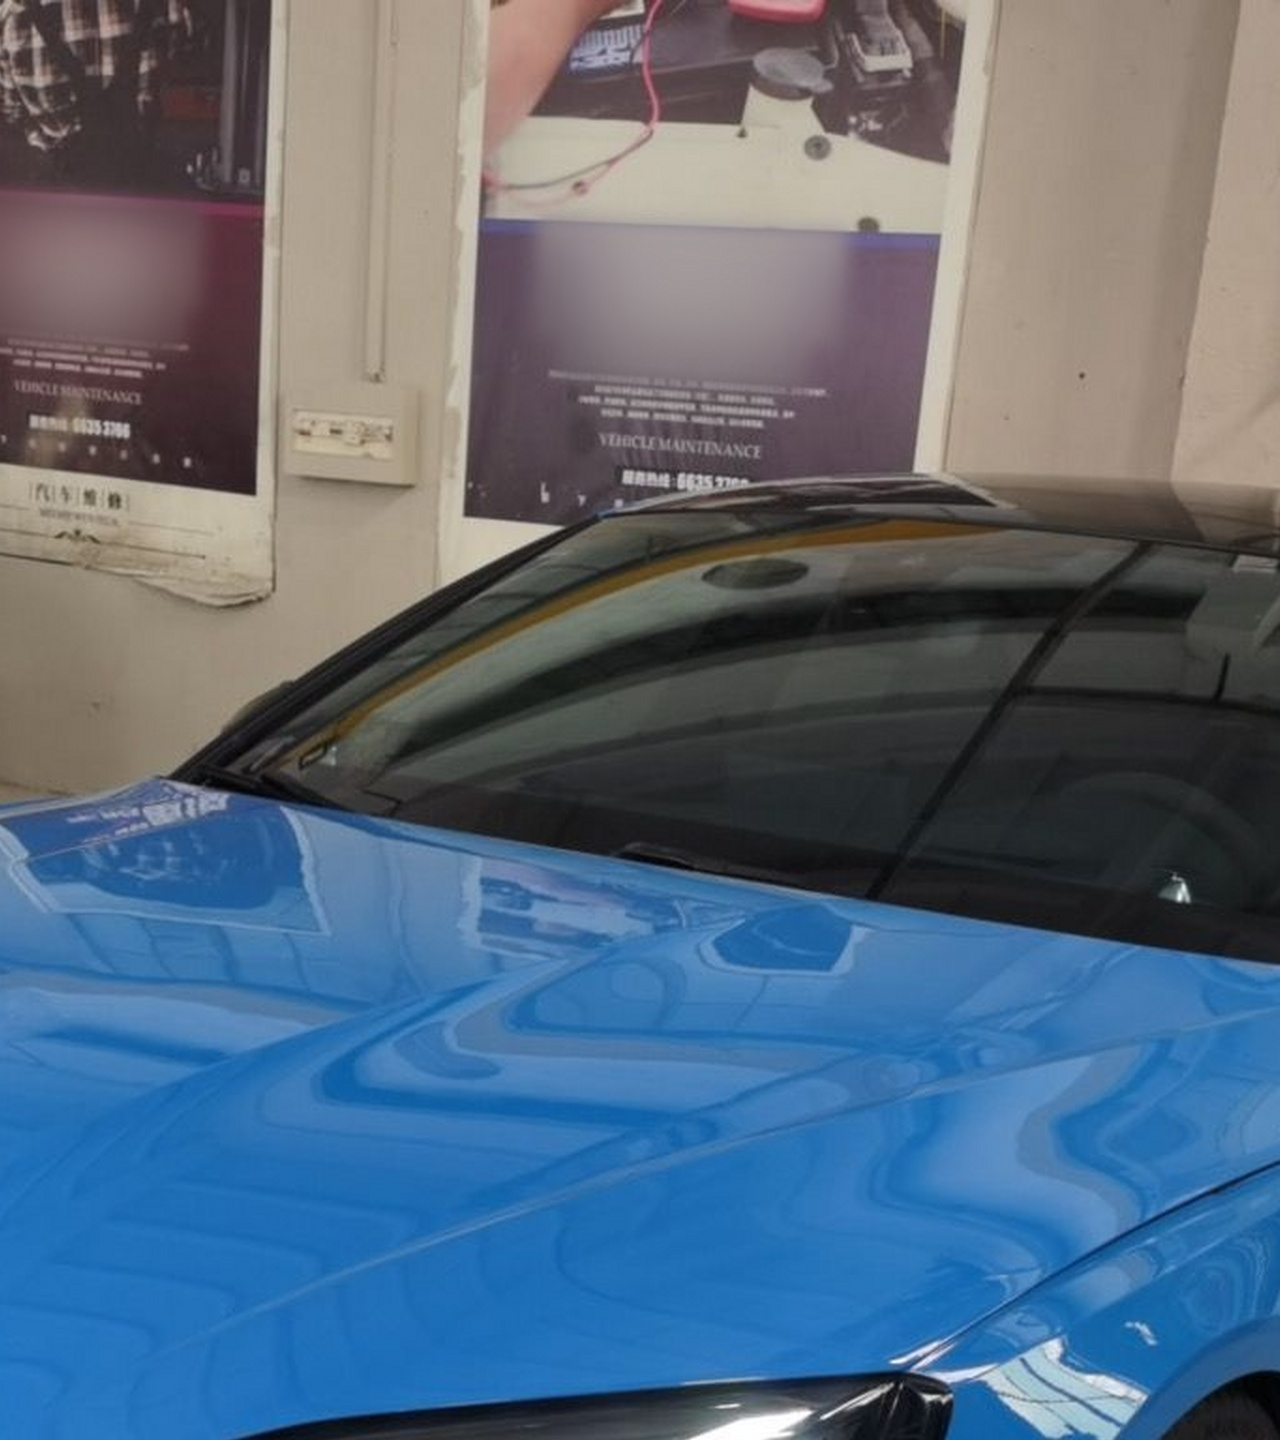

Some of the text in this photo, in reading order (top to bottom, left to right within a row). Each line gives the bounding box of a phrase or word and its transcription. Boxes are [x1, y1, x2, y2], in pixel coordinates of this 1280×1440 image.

[14, 379, 143, 405] VEHICLE MAINTENANCE
[598, 432, 763, 460] VEHICLE MAINTENANCE
[35, 482, 122, 510] 汽车维修
